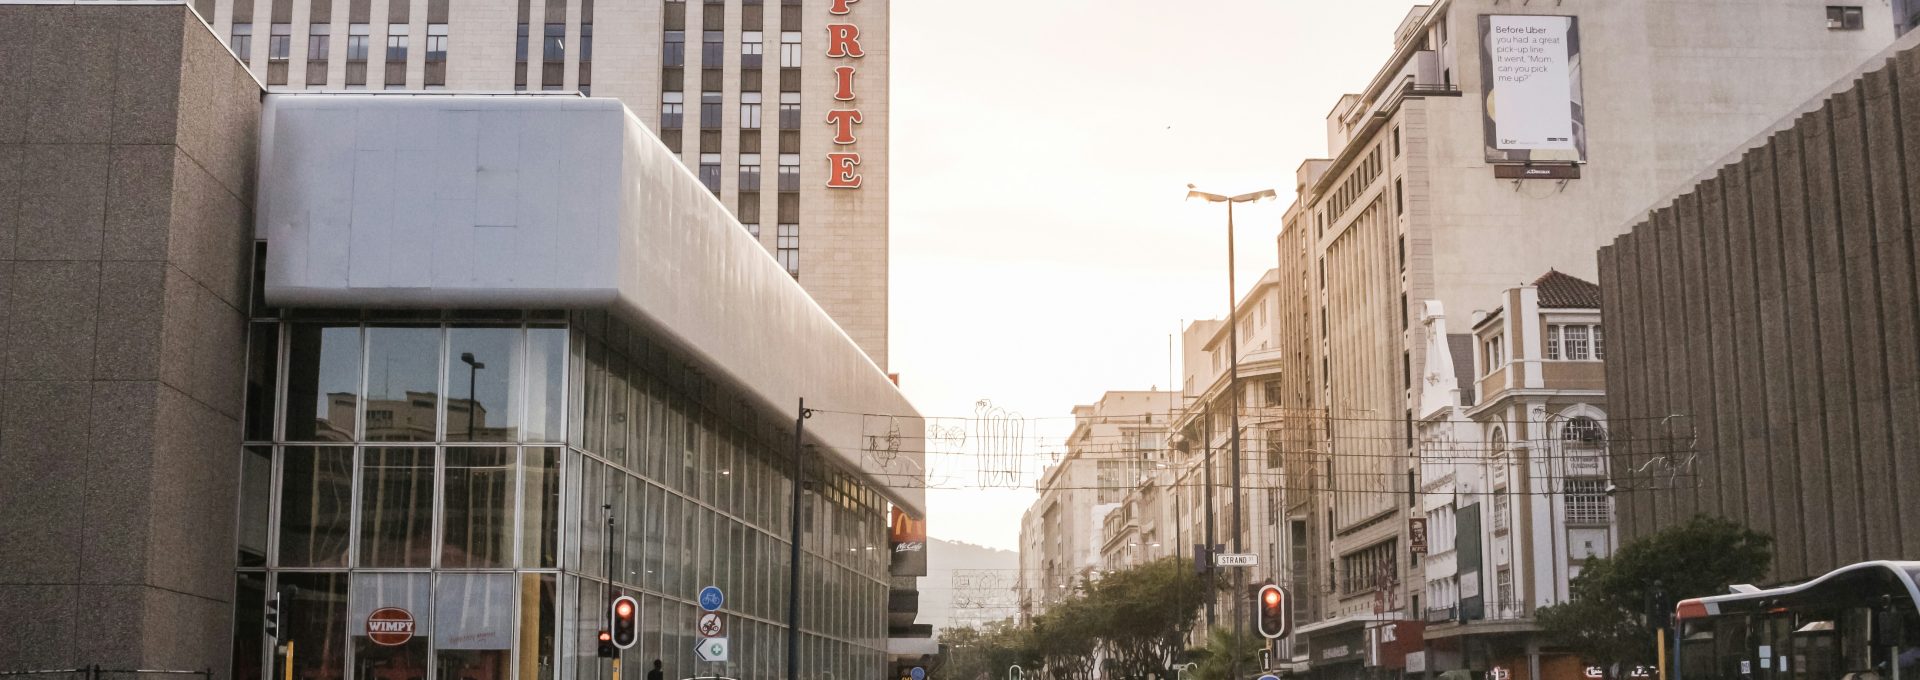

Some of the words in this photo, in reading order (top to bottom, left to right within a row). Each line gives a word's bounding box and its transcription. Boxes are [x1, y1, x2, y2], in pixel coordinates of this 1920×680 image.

[1495, 26, 1524, 34] Before
[1525, 26, 1546, 34] Uber
[1496, 37, 1511, 45] you
[1512, 36, 1529, 44] had
[1538, 37, 1560, 45] great
[1496, 46, 1529, 54] pick-up
[1514, 66, 1530, 74] you
[1530, 65, 1548, 73] pick
[1222, 556, 1247, 564] STRAND
[369, 621, 413, 632] WIMPY
